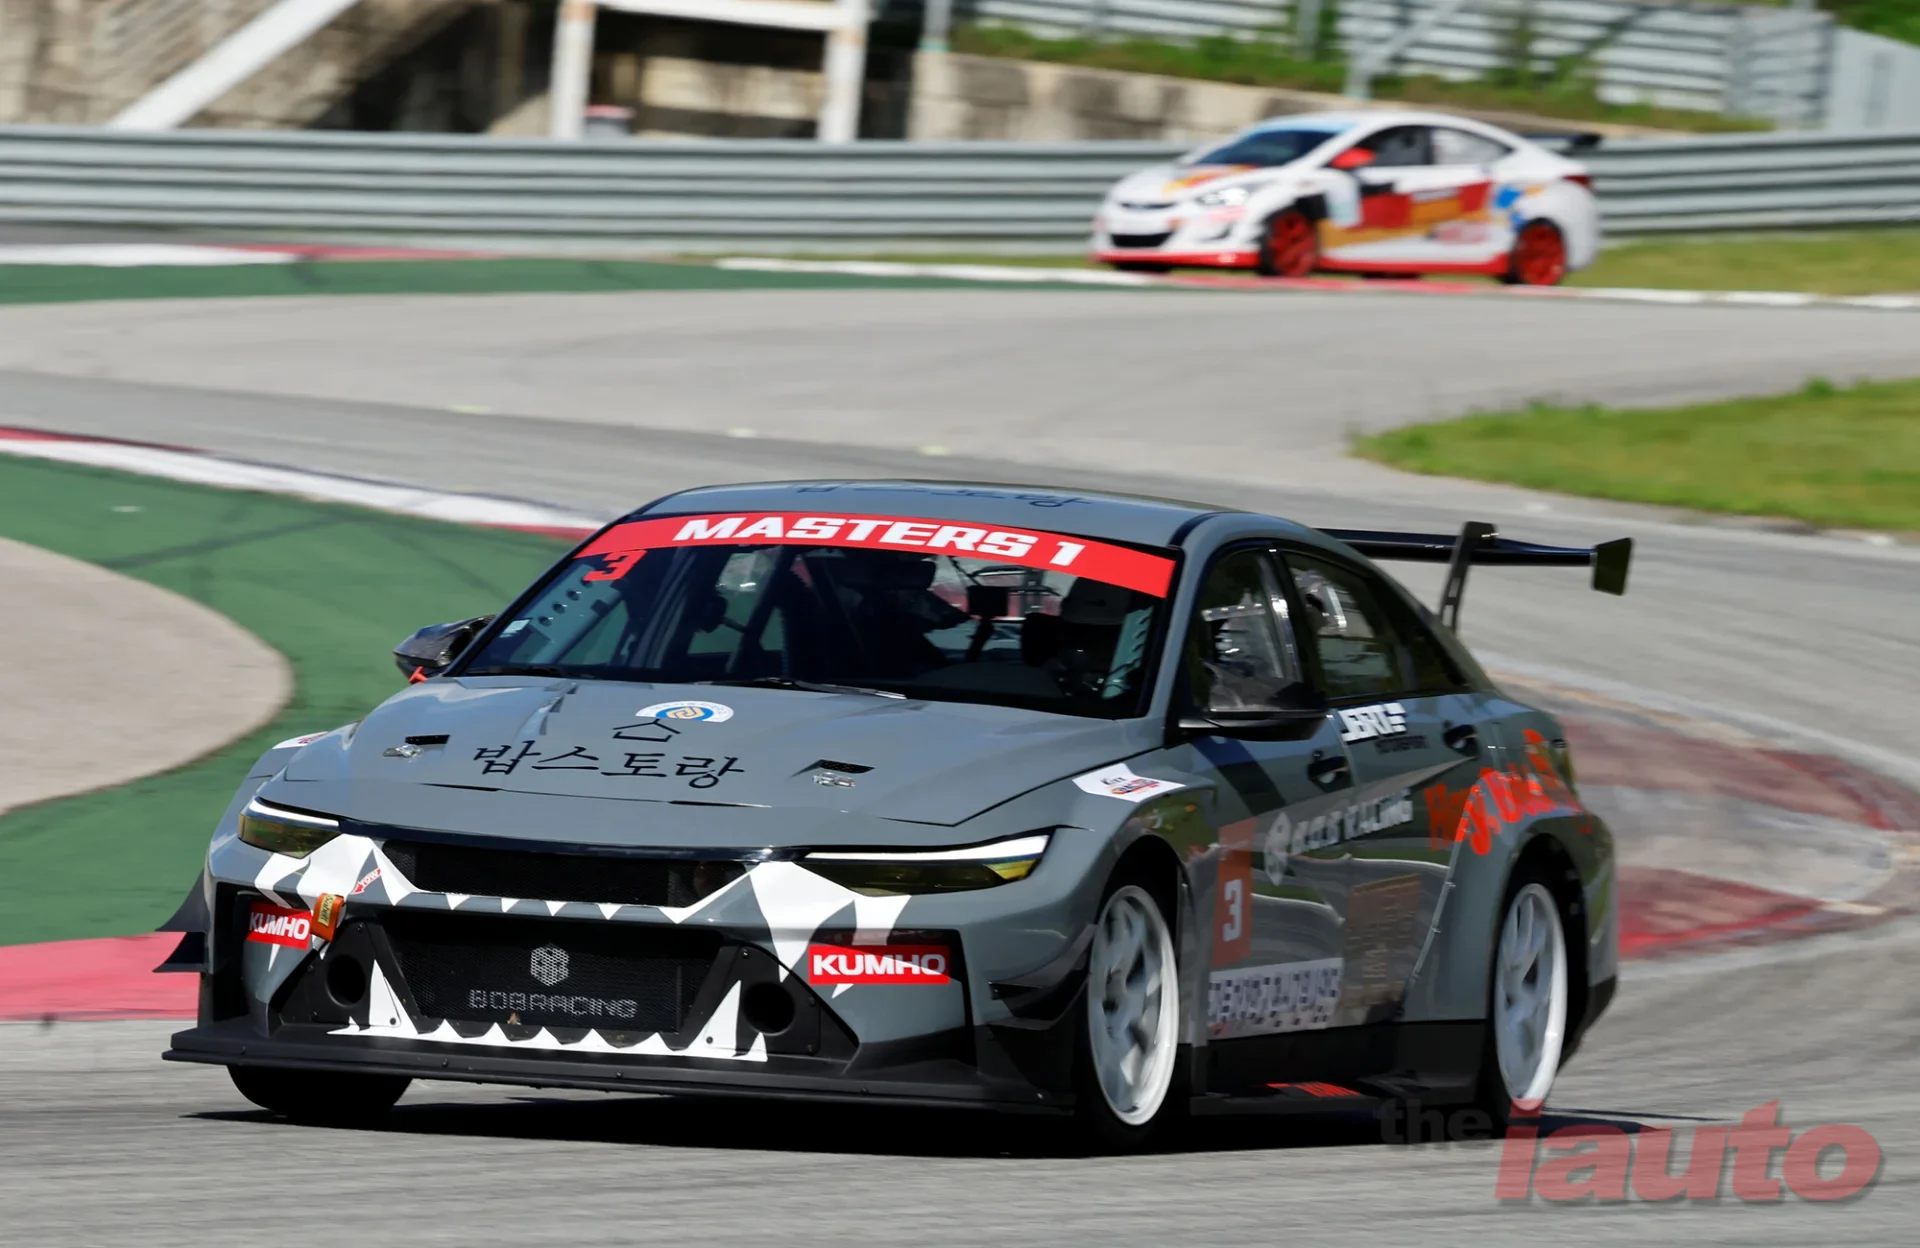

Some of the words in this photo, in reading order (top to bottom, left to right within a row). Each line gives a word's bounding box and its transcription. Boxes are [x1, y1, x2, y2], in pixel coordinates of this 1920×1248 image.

[673, 517, 1040, 558] MASTERS
[1049, 541, 1085, 567] 1
[583, 549, 648, 581] 3
[474, 740, 745, 789] 밥스토랑
[249, 911, 311, 941] KUMHO
[1223, 879, 1243, 942] 3
[813, 953, 946, 976] KUMHO
[469, 989, 638, 1019] BOBRACING
